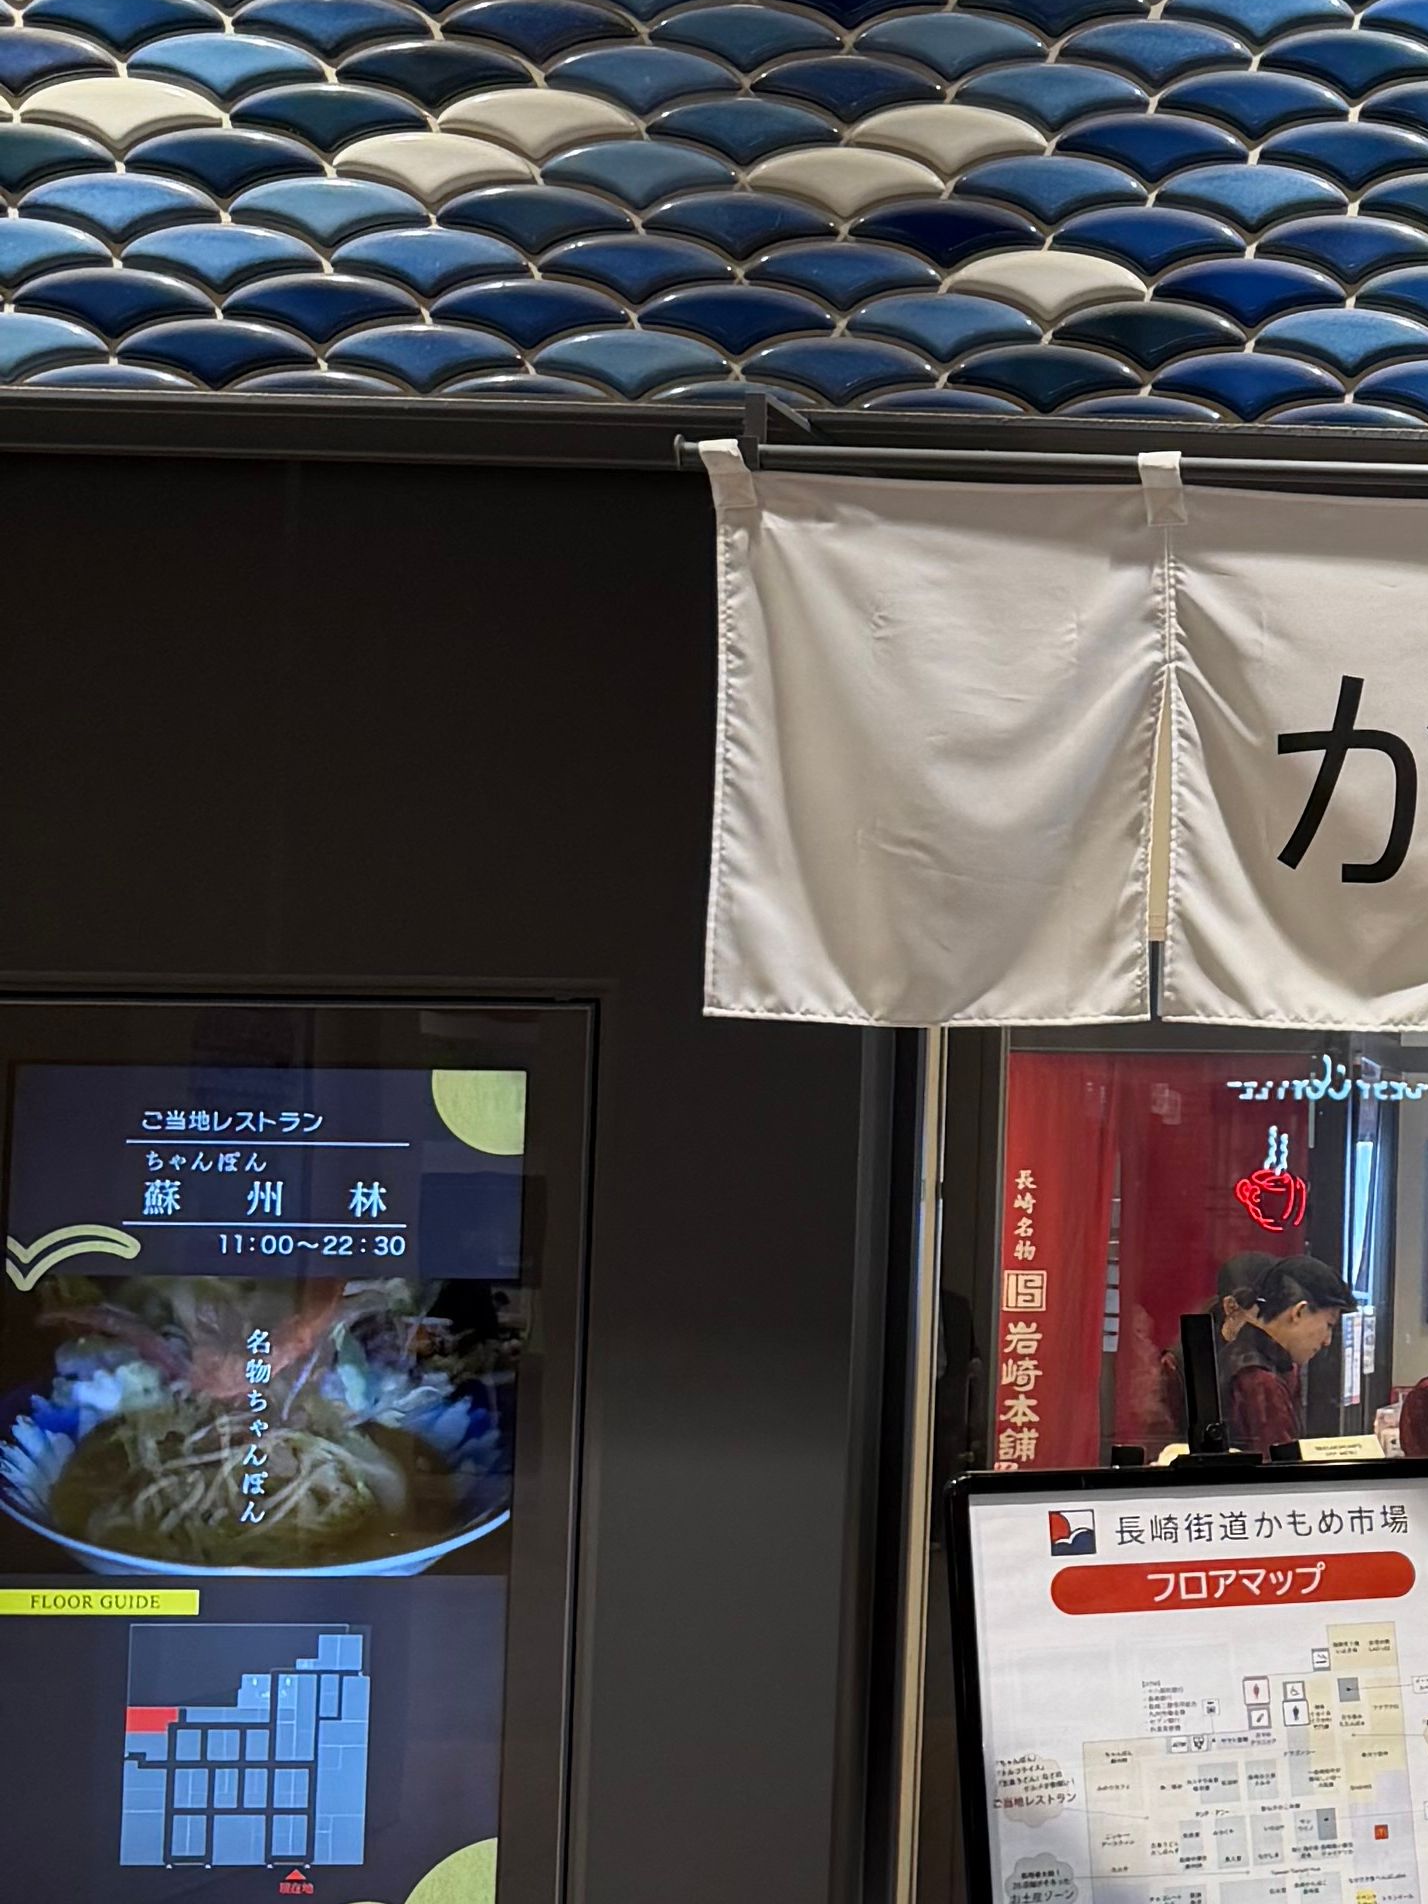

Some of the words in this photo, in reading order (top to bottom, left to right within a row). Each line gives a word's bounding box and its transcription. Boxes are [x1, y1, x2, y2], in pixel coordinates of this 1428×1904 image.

[140, 1110, 325, 1133] ご当地レストラン
[145, 1150, 267, 1173] ちゃんぽん
[1013, 1168, 1038, 1262] 長崎名物
[998, 1321, 1044, 1462] 岩崎本舗
[240, 1329, 272, 1524] 名物ちゃんぽん
[1115, 1503, 1410, 1547] 長崎街道かもめ市場
[30, 1594, 94, 1610] FLOOR
[99, 1594, 161, 1610] GUIDE
[1147, 1561, 1326, 1603] フロアマップ
